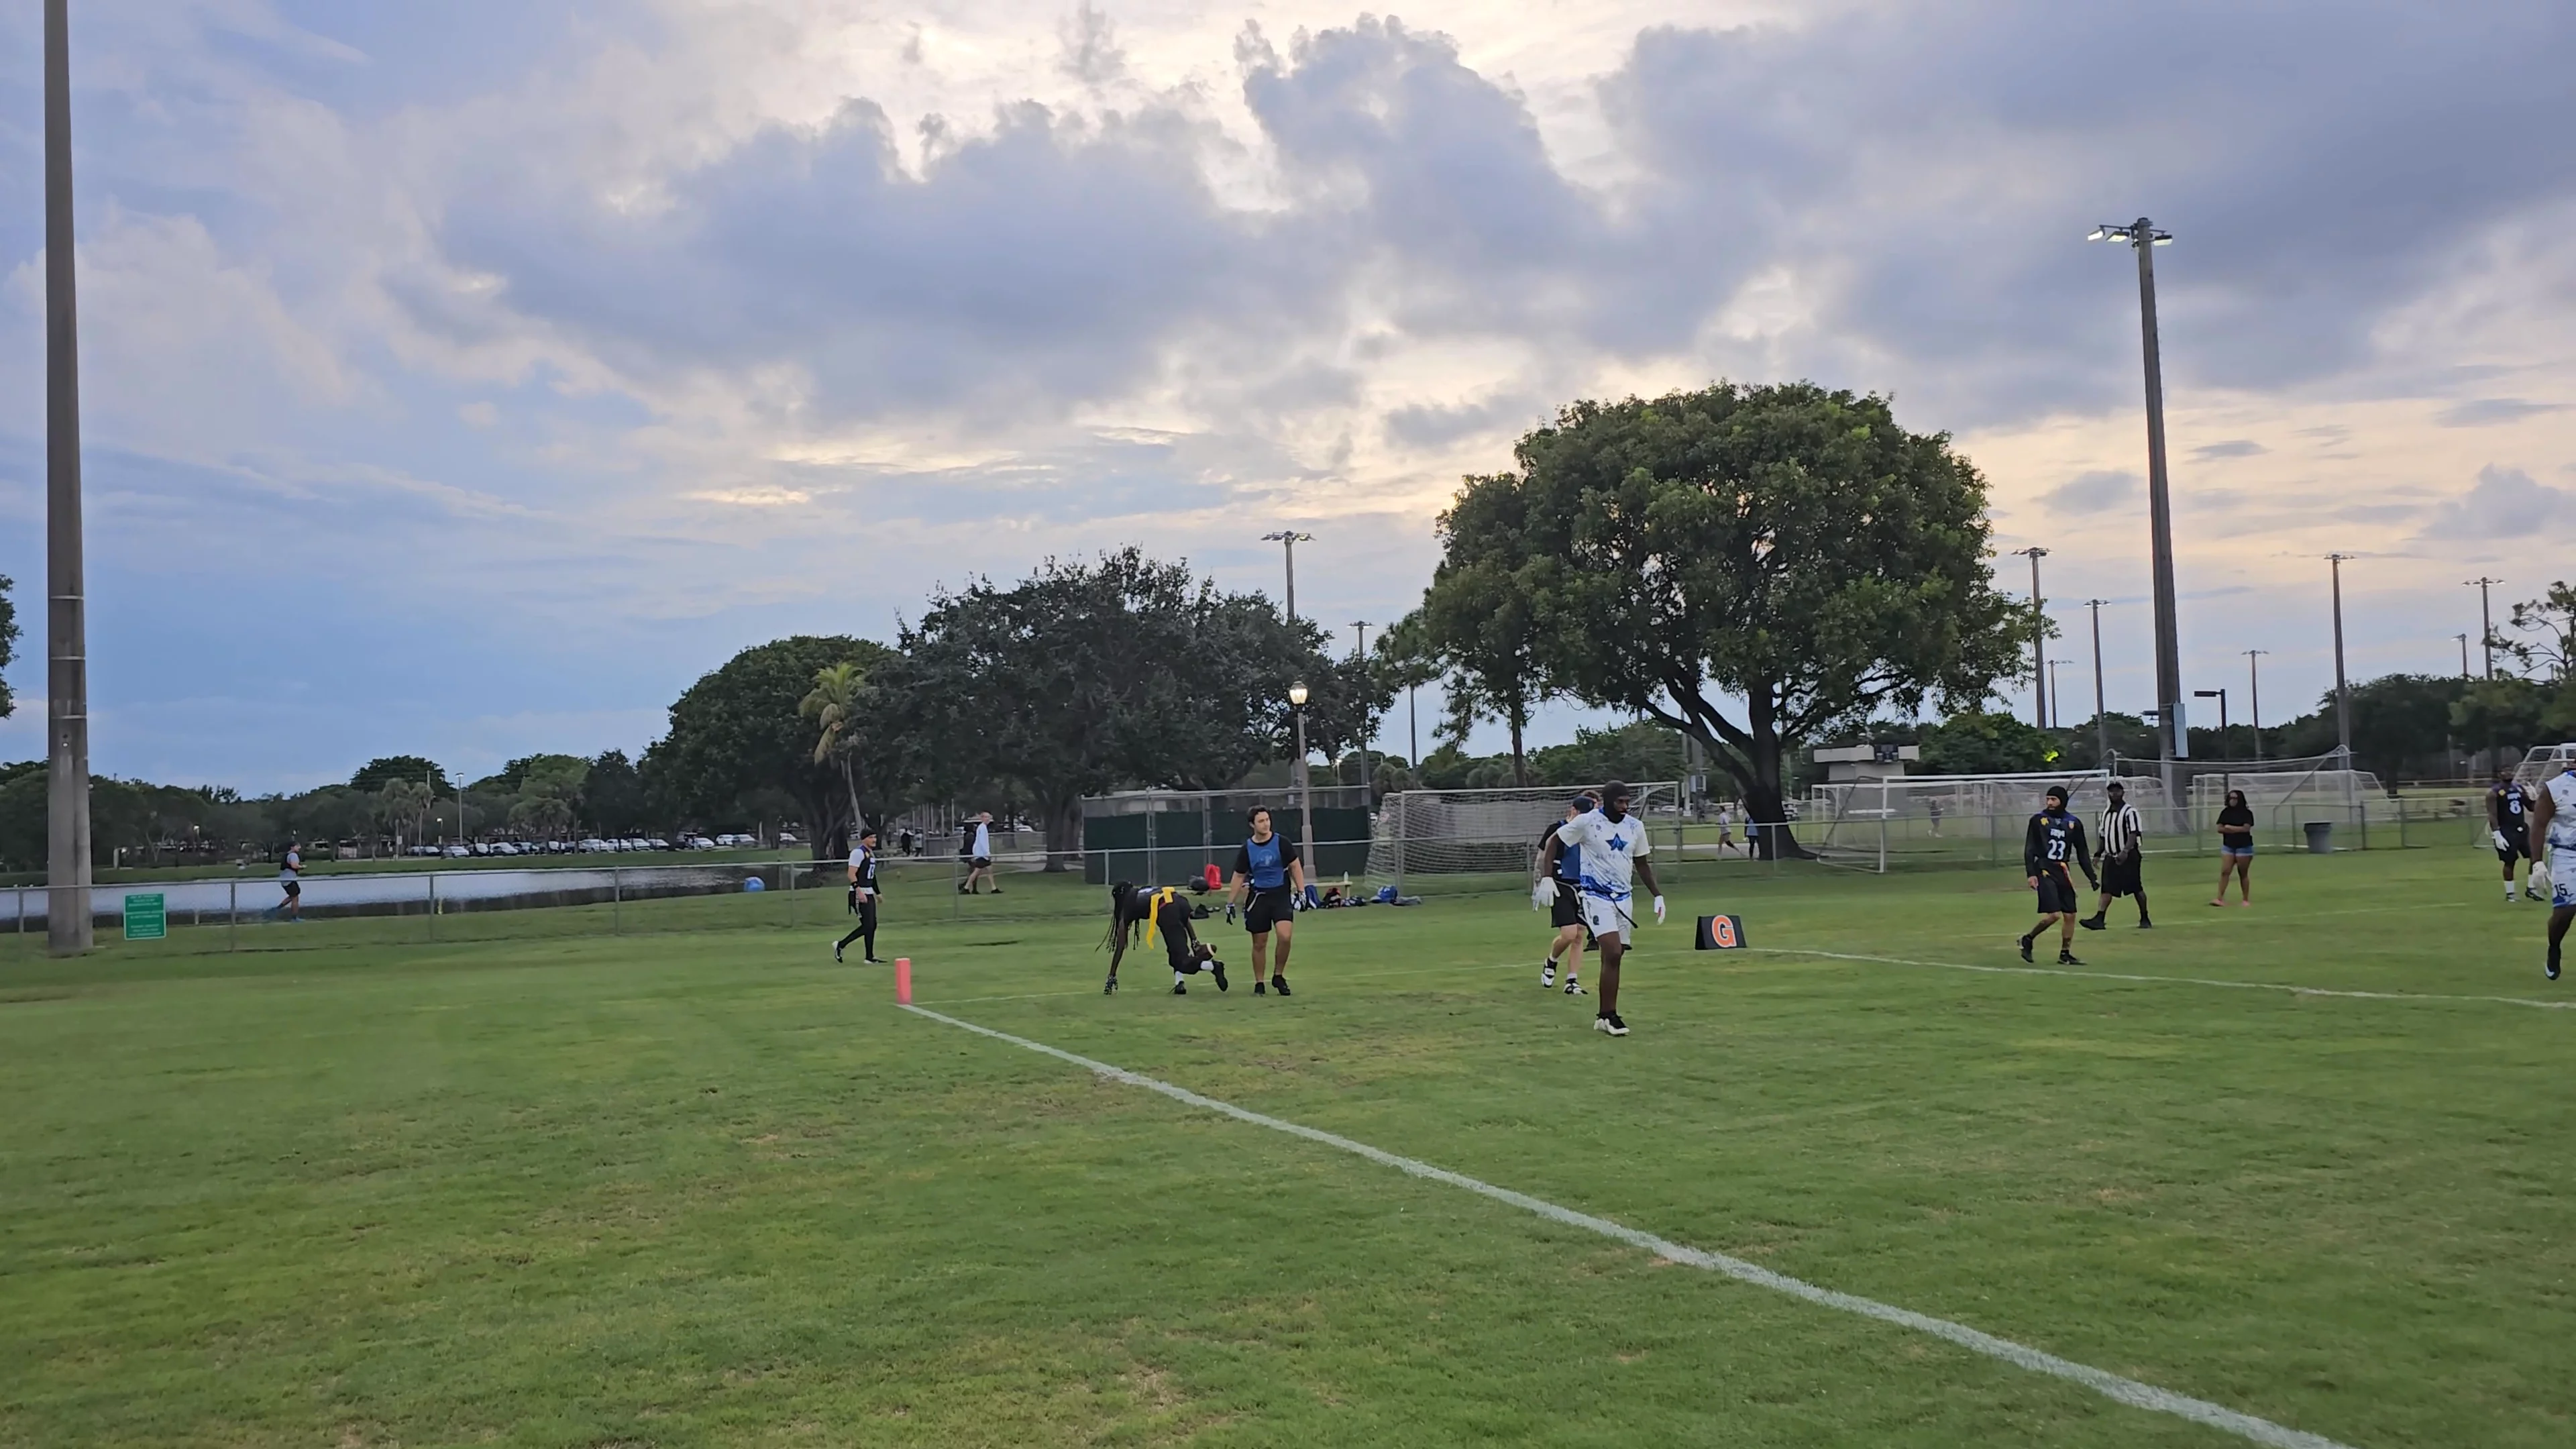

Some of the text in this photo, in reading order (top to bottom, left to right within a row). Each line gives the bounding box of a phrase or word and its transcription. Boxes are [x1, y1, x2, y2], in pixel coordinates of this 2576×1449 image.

[2510, 800, 2522, 814] 8
[2047, 839, 2066, 860] 23
[2555, 883, 2568, 896] 15
[1711, 914, 1737, 948] G
